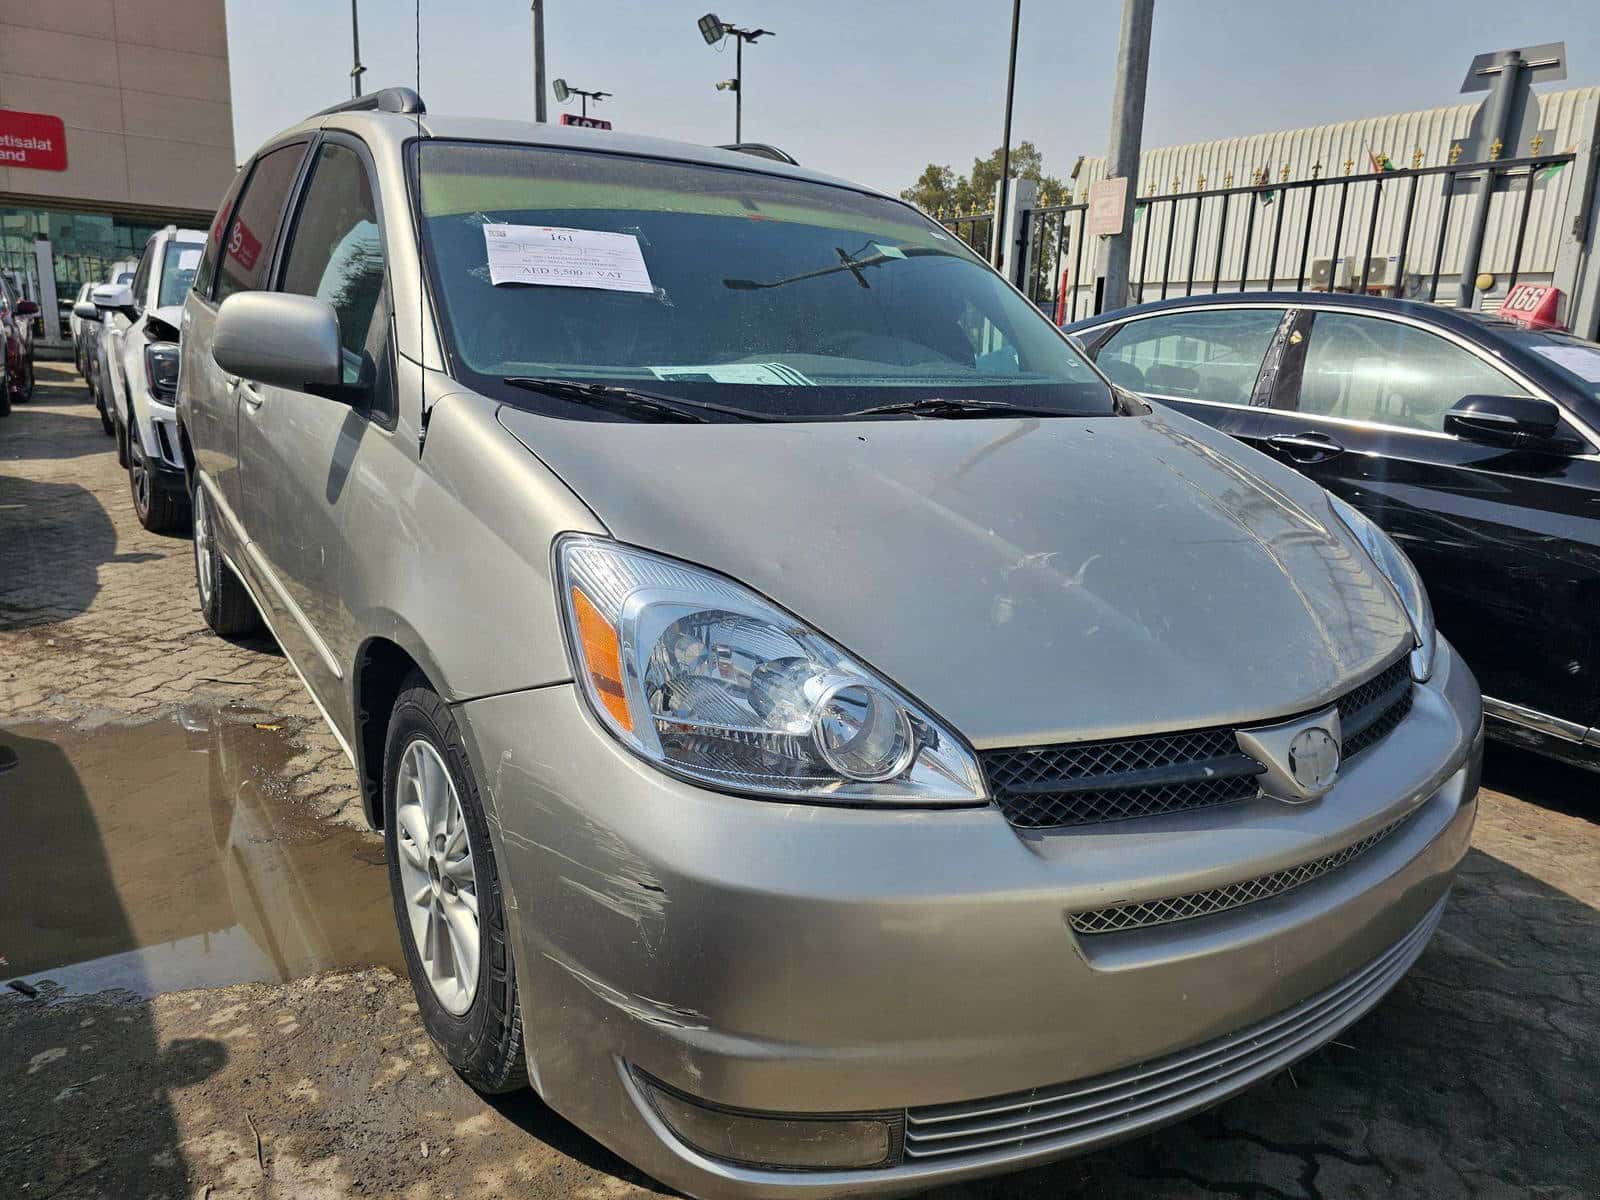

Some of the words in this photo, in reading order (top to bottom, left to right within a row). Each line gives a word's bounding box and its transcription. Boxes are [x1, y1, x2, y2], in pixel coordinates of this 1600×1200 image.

[551, 233, 574, 242] 161
[521, 266, 549, 275] AED
[552, 268, 583, 277] 5,500
[596, 271, 623, 279] VAT
[1506, 286, 1545, 311] 166
